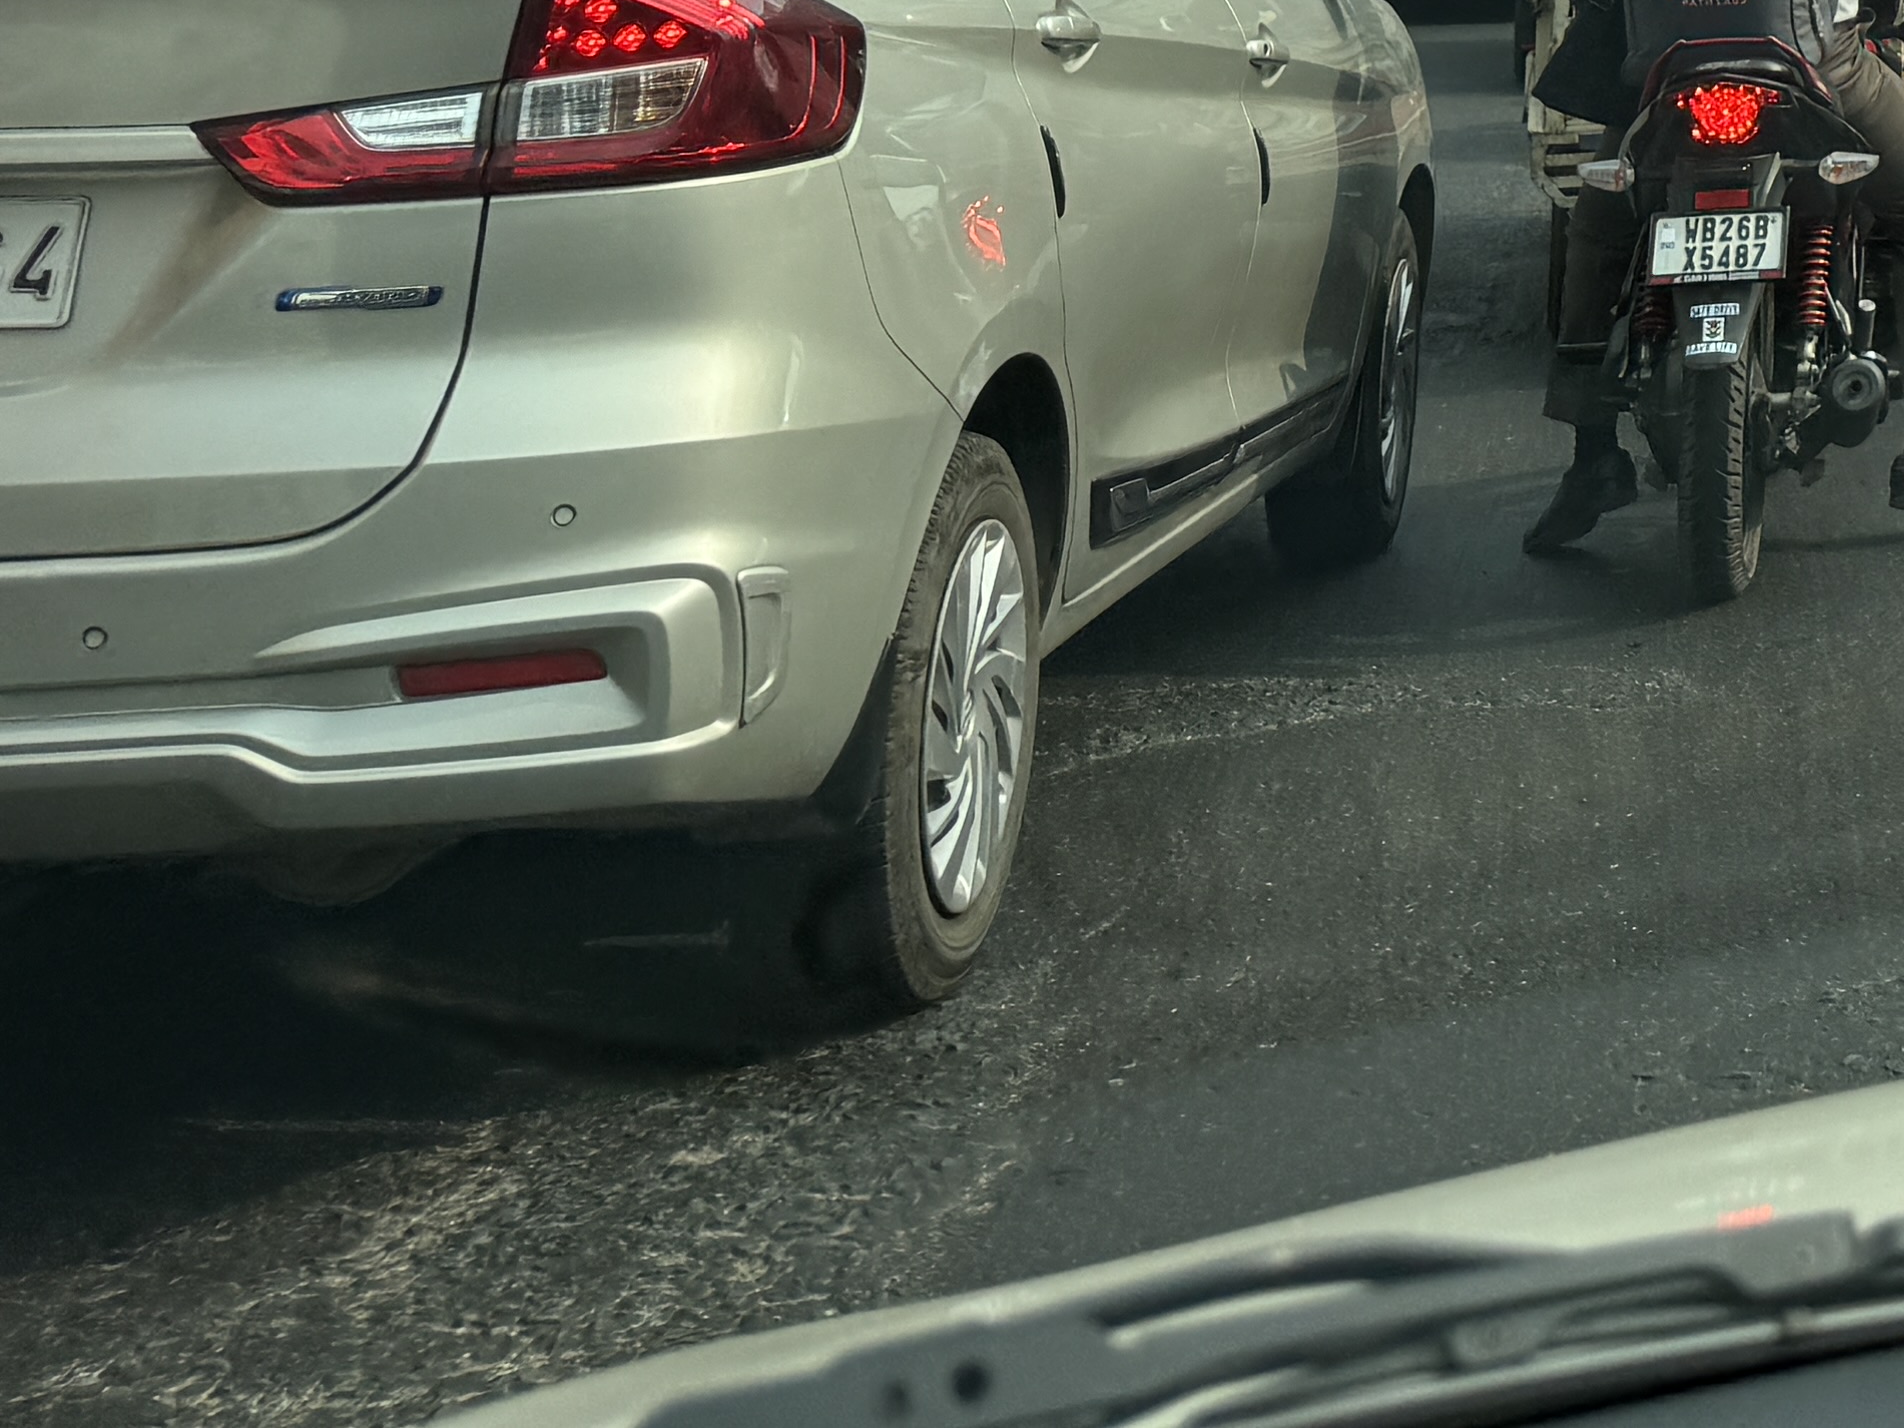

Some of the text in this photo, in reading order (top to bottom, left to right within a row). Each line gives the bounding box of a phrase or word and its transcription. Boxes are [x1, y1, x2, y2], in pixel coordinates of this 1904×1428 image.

[1684, 214, 1770, 244] WB26B
[0, 225, 61, 297] 4
[1682, 242, 1767, 272] X5487
